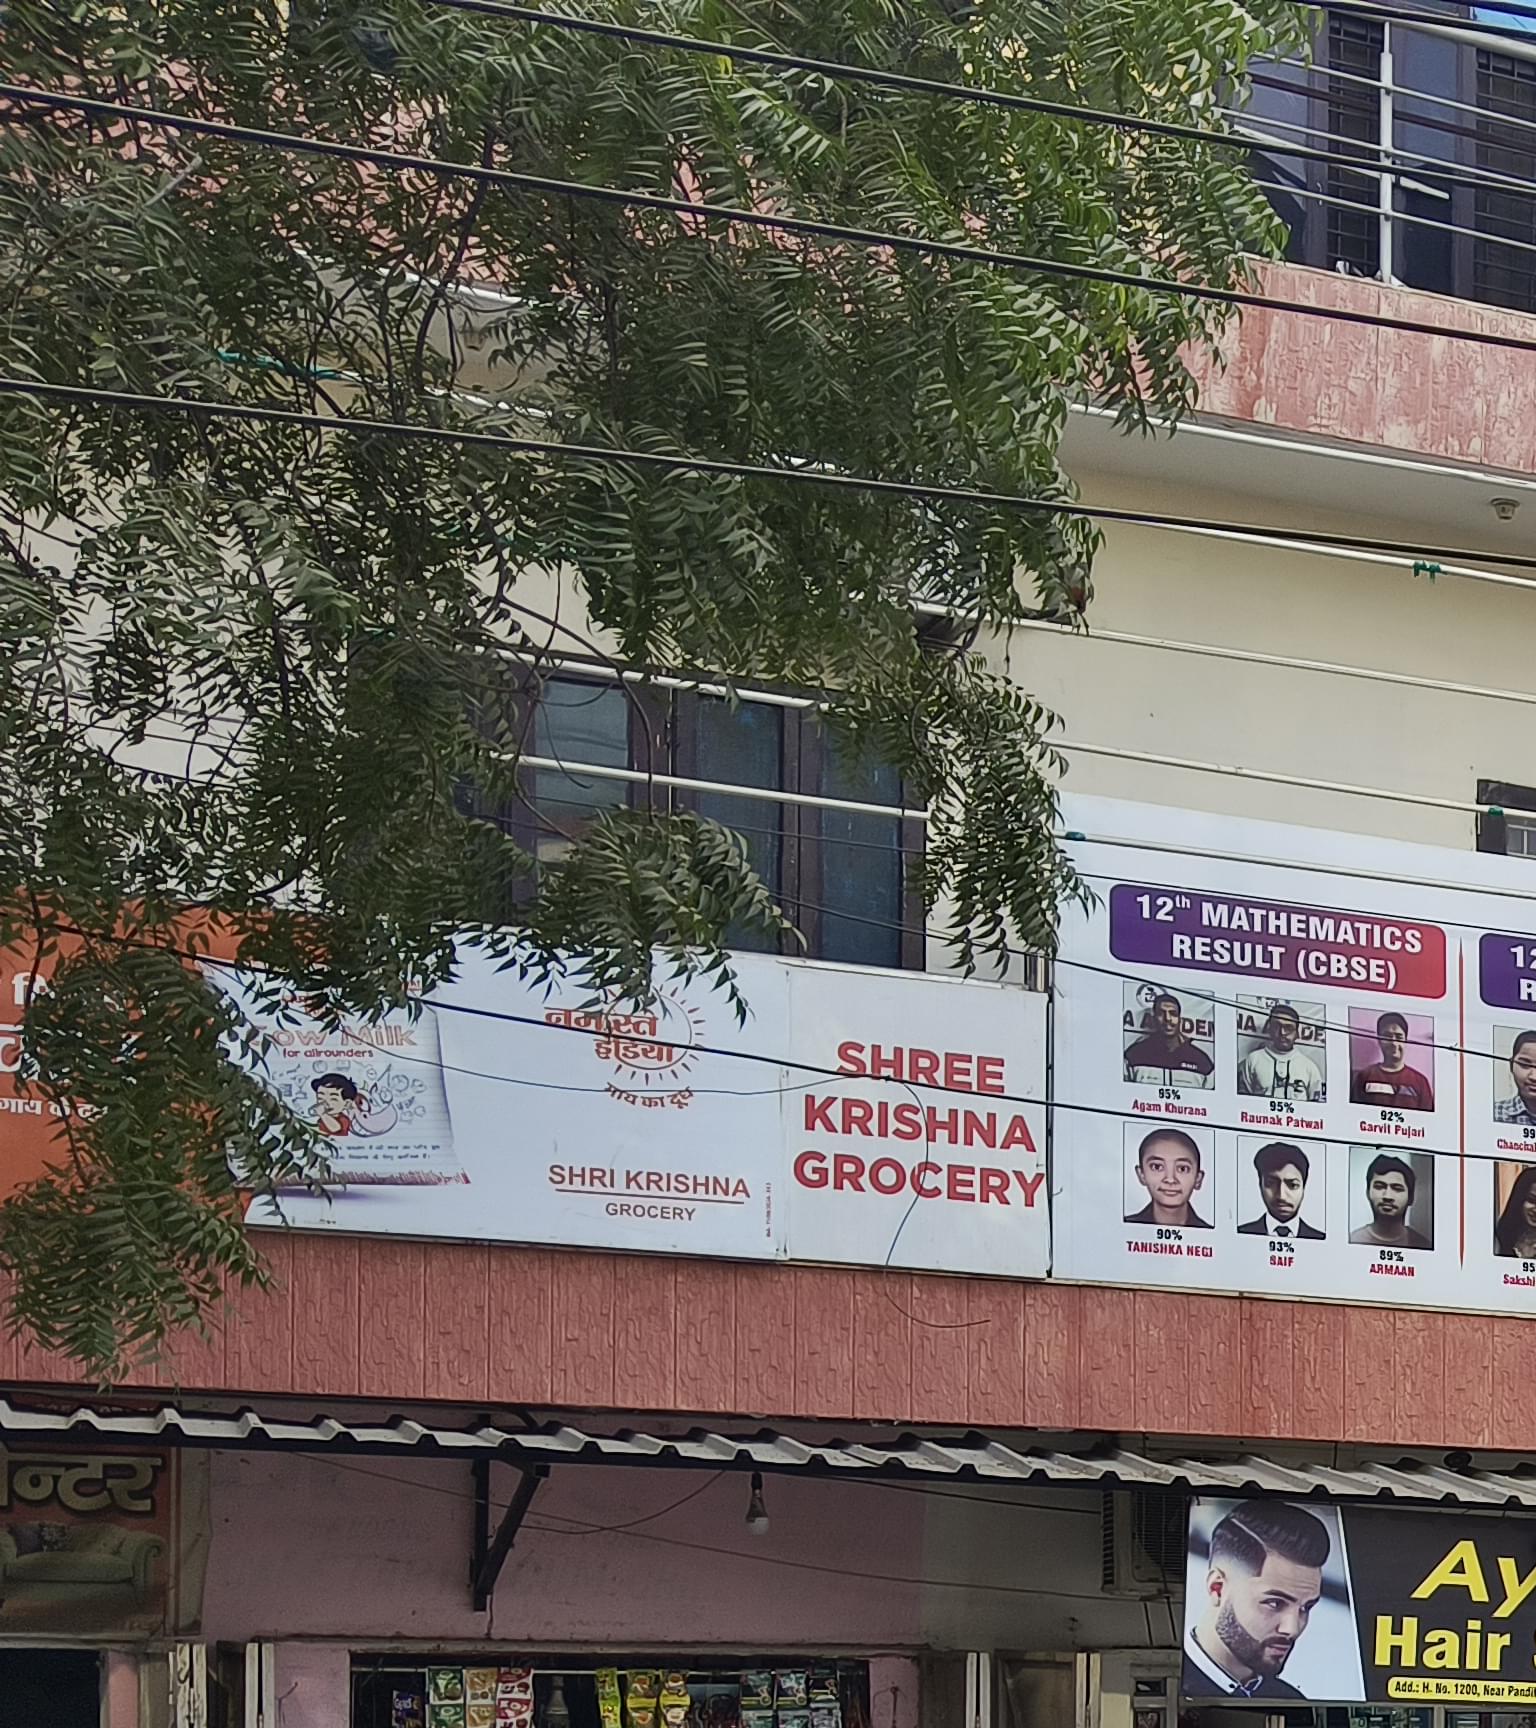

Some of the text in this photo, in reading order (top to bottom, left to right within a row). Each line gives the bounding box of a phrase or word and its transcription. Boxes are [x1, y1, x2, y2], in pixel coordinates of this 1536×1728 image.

[1136, 894, 1423, 954] 12th MATHEMATICS
[1172, 934, 1398, 990] RESULT (CBSE)
[341, 1024, 419, 1047] Milk
[283, 1049, 301, 1058] for
[835, 1040, 1006, 1093] SHREE
[1269, 1100, 1295, 1114] 95%
[803, 1096, 1037, 1153] KRISHNA
[1241, 1112, 1283, 1128] Raunak
[1380, 1110, 1405, 1123] 92%
[549, 1164, 750, 1198] SHRI KRISHNA
[793, 1155, 1045, 1208] GROCERY
[606, 1202, 696, 1221] GROCERY
[1156, 1228, 1183, 1241] 90%
[1269, 1241, 1294, 1253] 93%
[1269, 1255, 1294, 1268] SAIF
[1379, 1250, 1404, 1263] 89%
[1369, 1264, 1415, 1278] ARMAAN
[1503, 1273, 1536, 1287] Sakshi
[0, 1446, 163, 1512] न्टर
[1373, 1615, 1512, 1672] Hair
[1435, 1682, 1451, 1694] No.
[1453, 1683, 1480, 1697] 1200,
[1483, 1684, 1505, 1696] Near
